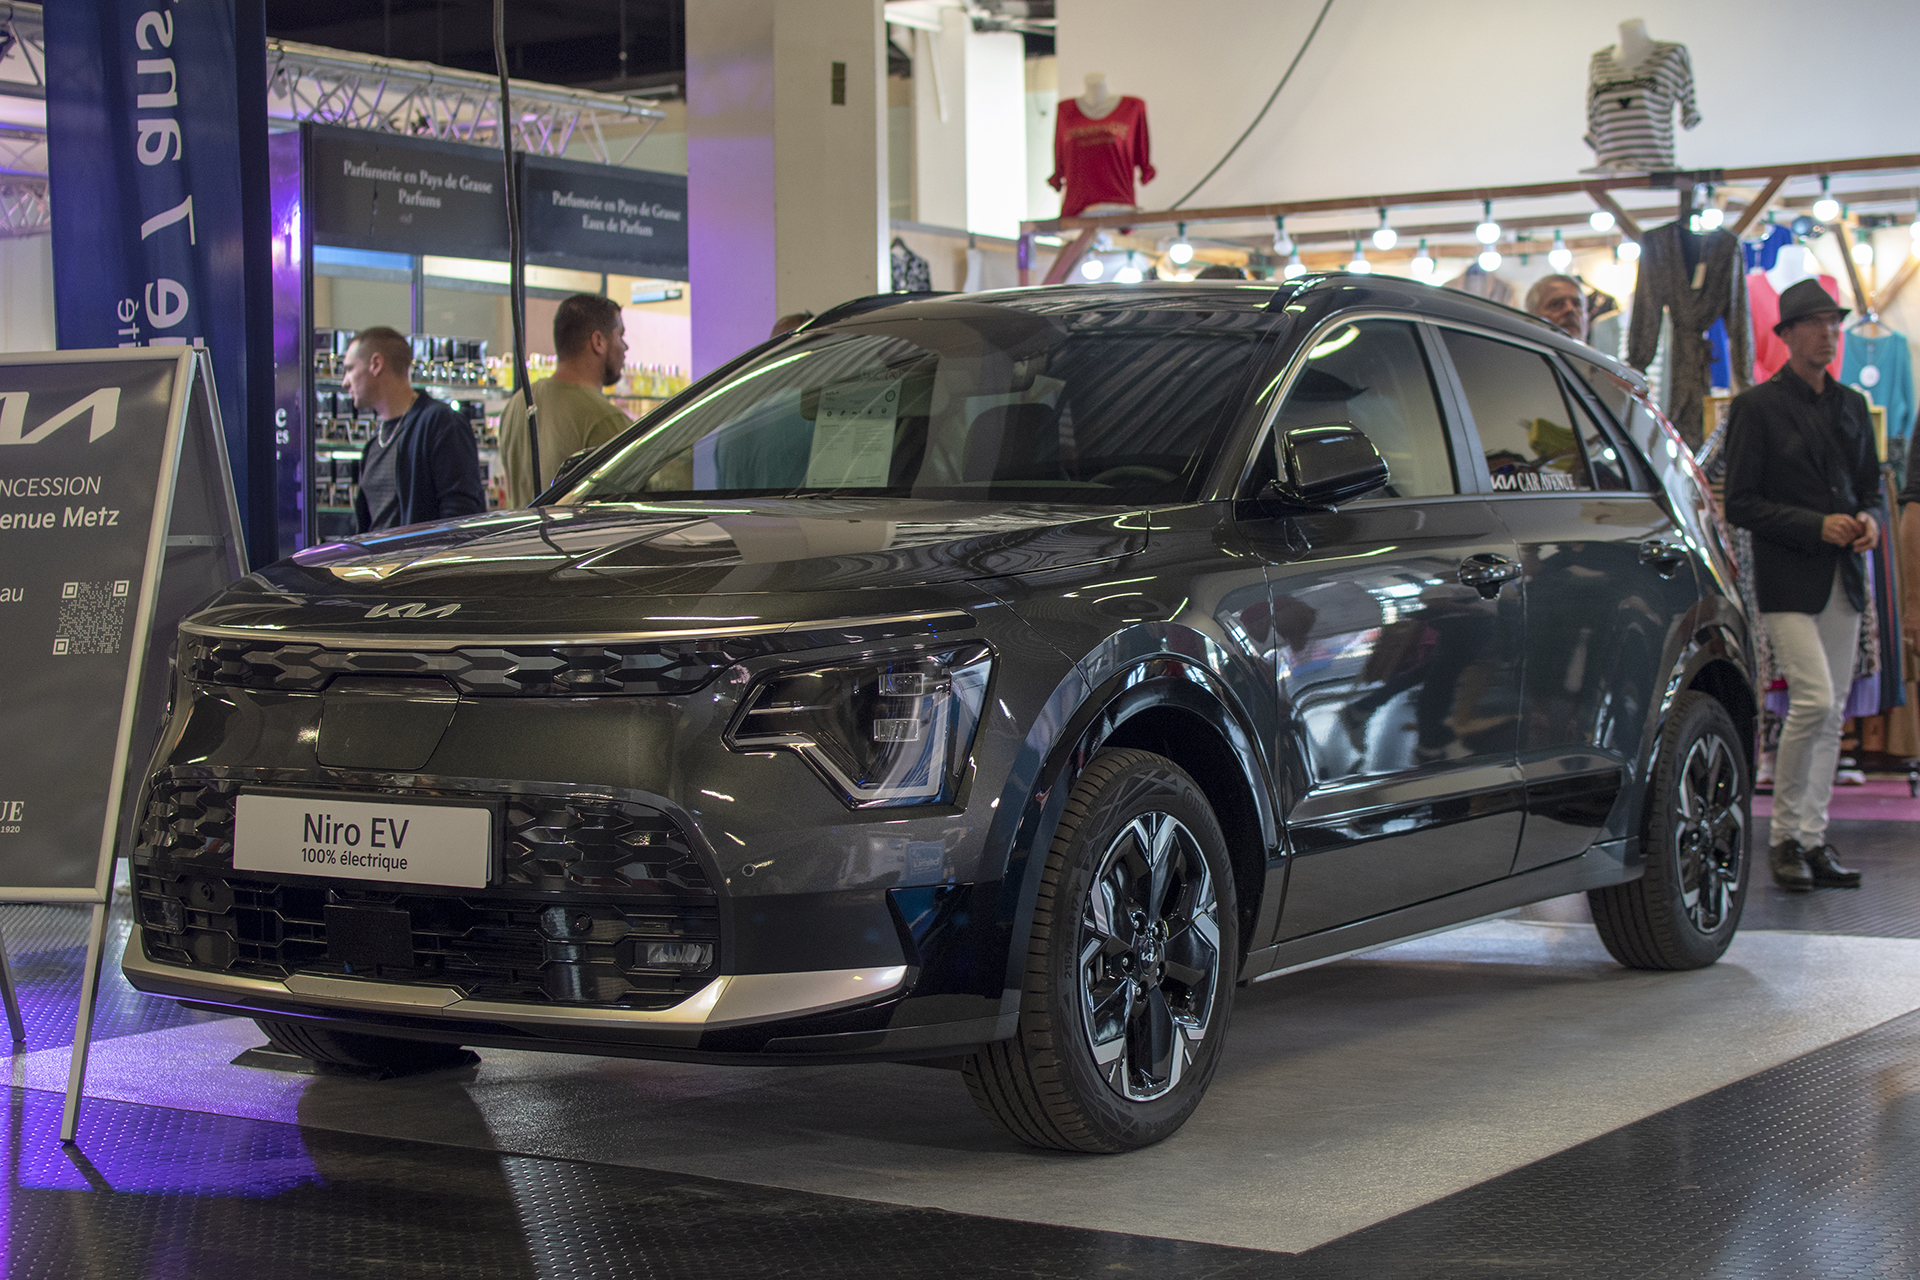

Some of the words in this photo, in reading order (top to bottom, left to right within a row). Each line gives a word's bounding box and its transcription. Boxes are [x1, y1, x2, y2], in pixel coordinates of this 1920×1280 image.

[343, 159, 402, 182] Parfumerie
[403, 171, 417, 184] en
[419, 169, 443, 190] Pays
[444, 173, 458, 190] de
[459, 175, 493, 194] Grasse
[398, 188, 441, 209] Parfums
[552, 190, 602, 210] Parfumerie
[604, 200, 616, 212] en
[618, 198, 638, 218] Pays
[639, 201, 651, 217] de
[652, 203, 681, 221] Grasse
[582, 214, 605, 231] Eaux
[606, 217, 618, 233] de
[1516, 472, 1541, 492] CAR
[1540, 473, 1577, 491] AVENUE
[62, 507, 120, 528] Metz
[364, 602, 461, 618] KIA
[0, 825, 21, 834] 1920
[303, 812, 361, 847] Niro
[370, 816, 410, 850] EV
[301, 847, 337, 865] 100%
[340, 850, 408, 872] électrique
